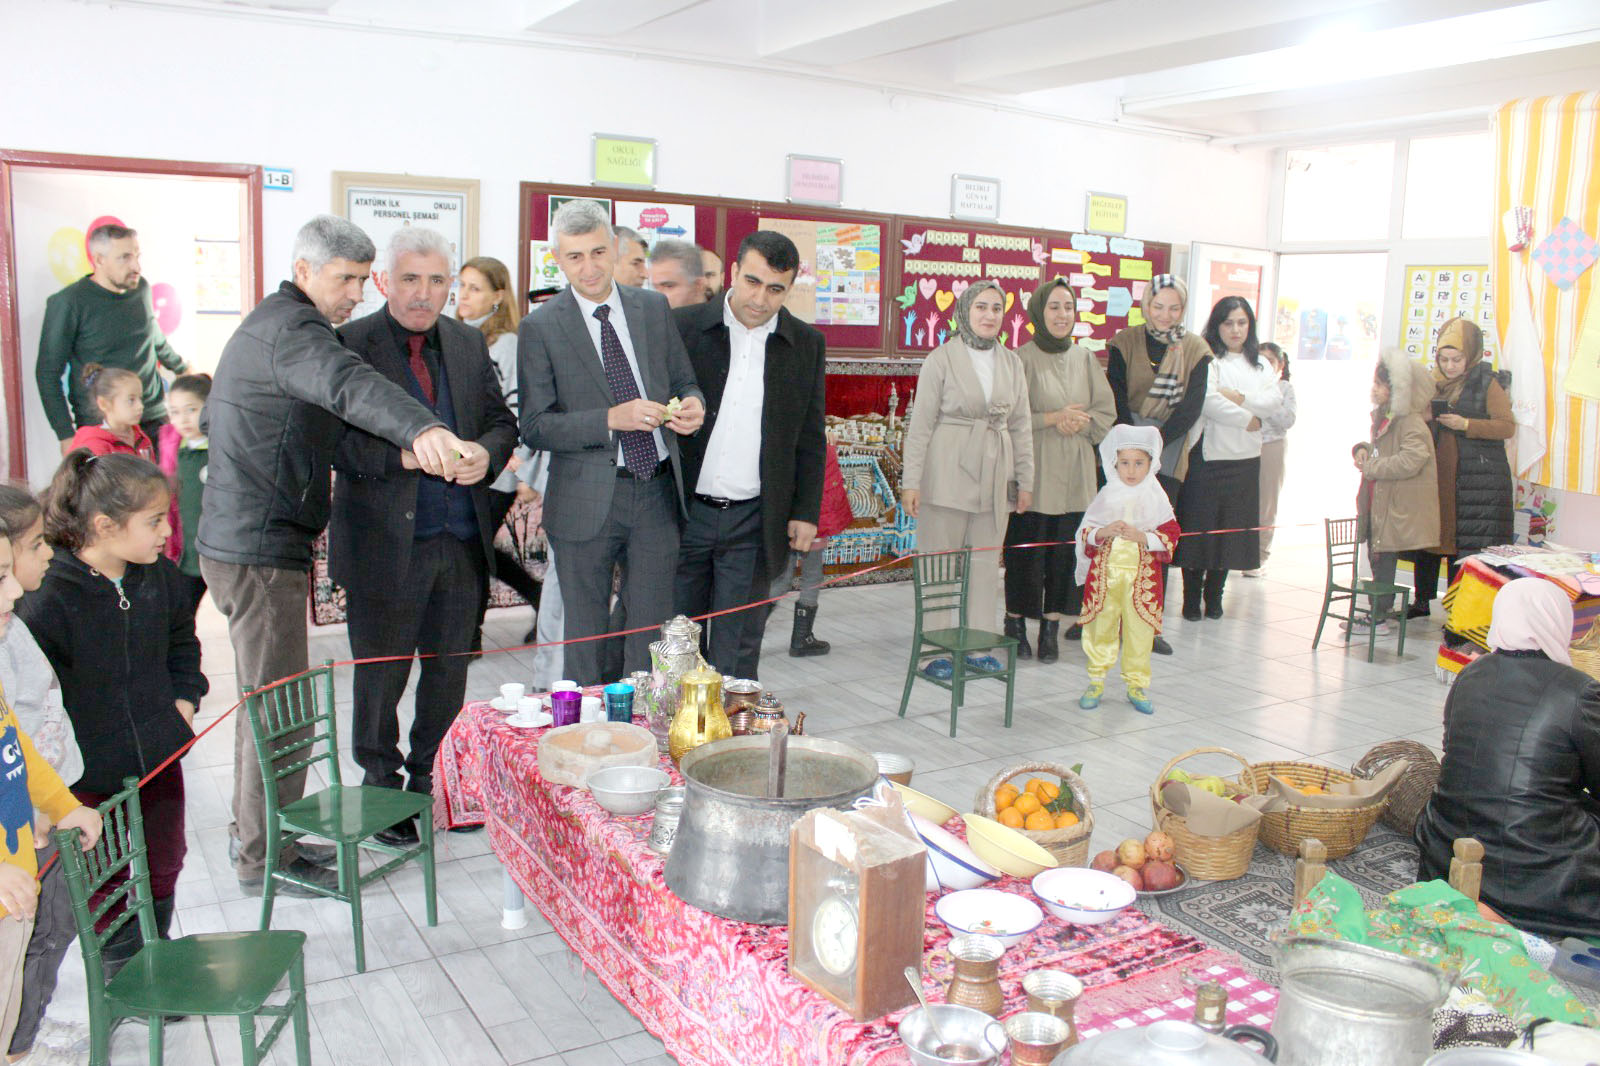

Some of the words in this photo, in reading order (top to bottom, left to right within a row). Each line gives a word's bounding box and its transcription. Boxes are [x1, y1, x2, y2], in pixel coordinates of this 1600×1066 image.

[611, 144, 637, 154] OKUL
[606, 155, 642, 168] SAĞLIĞI
[266, 173, 290, 185] 1-B
[355, 197, 387, 207] ATATÜRK
[388, 198, 400, 207] İLK
[433, 201, 457, 211] OKULU
[373, 209, 411, 219] PERSONEL
[413, 211, 439, 221] ŞEMASI
